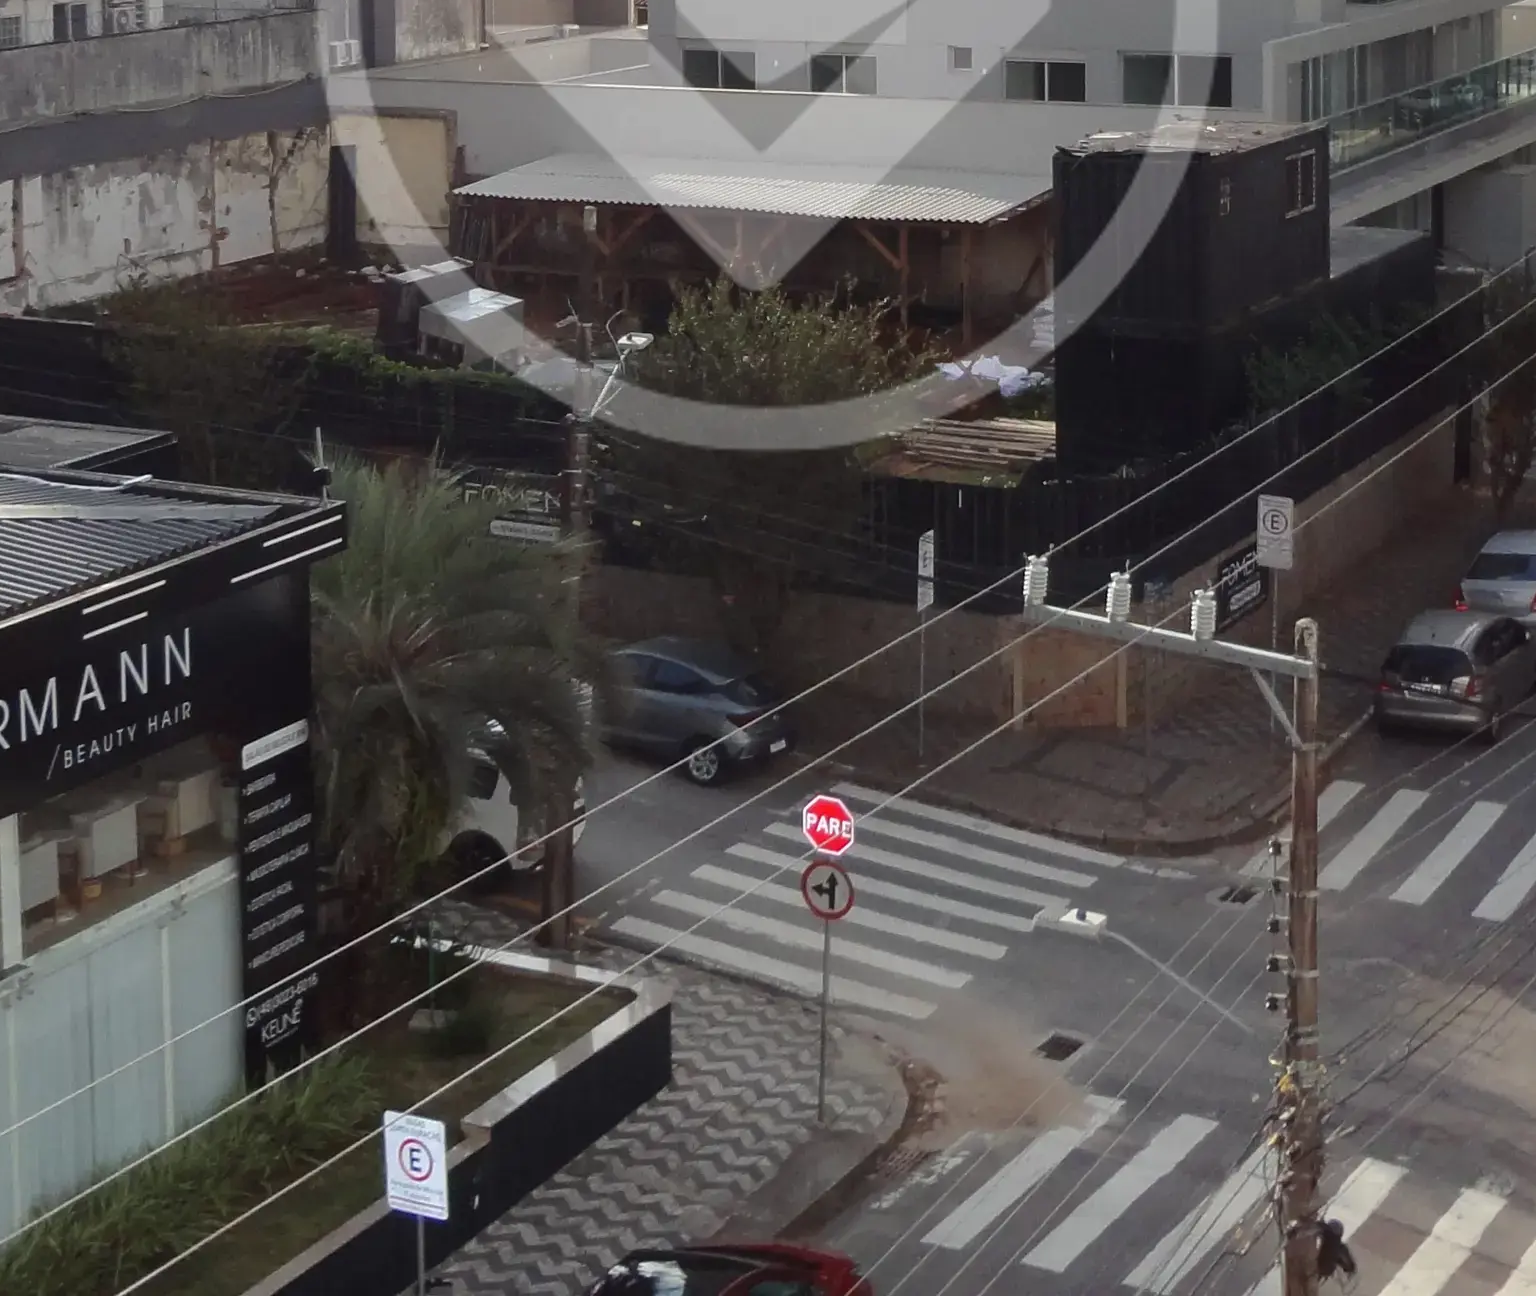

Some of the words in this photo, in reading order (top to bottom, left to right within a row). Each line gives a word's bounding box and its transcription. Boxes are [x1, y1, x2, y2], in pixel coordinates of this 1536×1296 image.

[1269, 513, 1281, 531] E
[148, 700, 193, 731] HAIR
[806, 812, 852, 839] PARE
[409, 1147, 423, 1173] E
